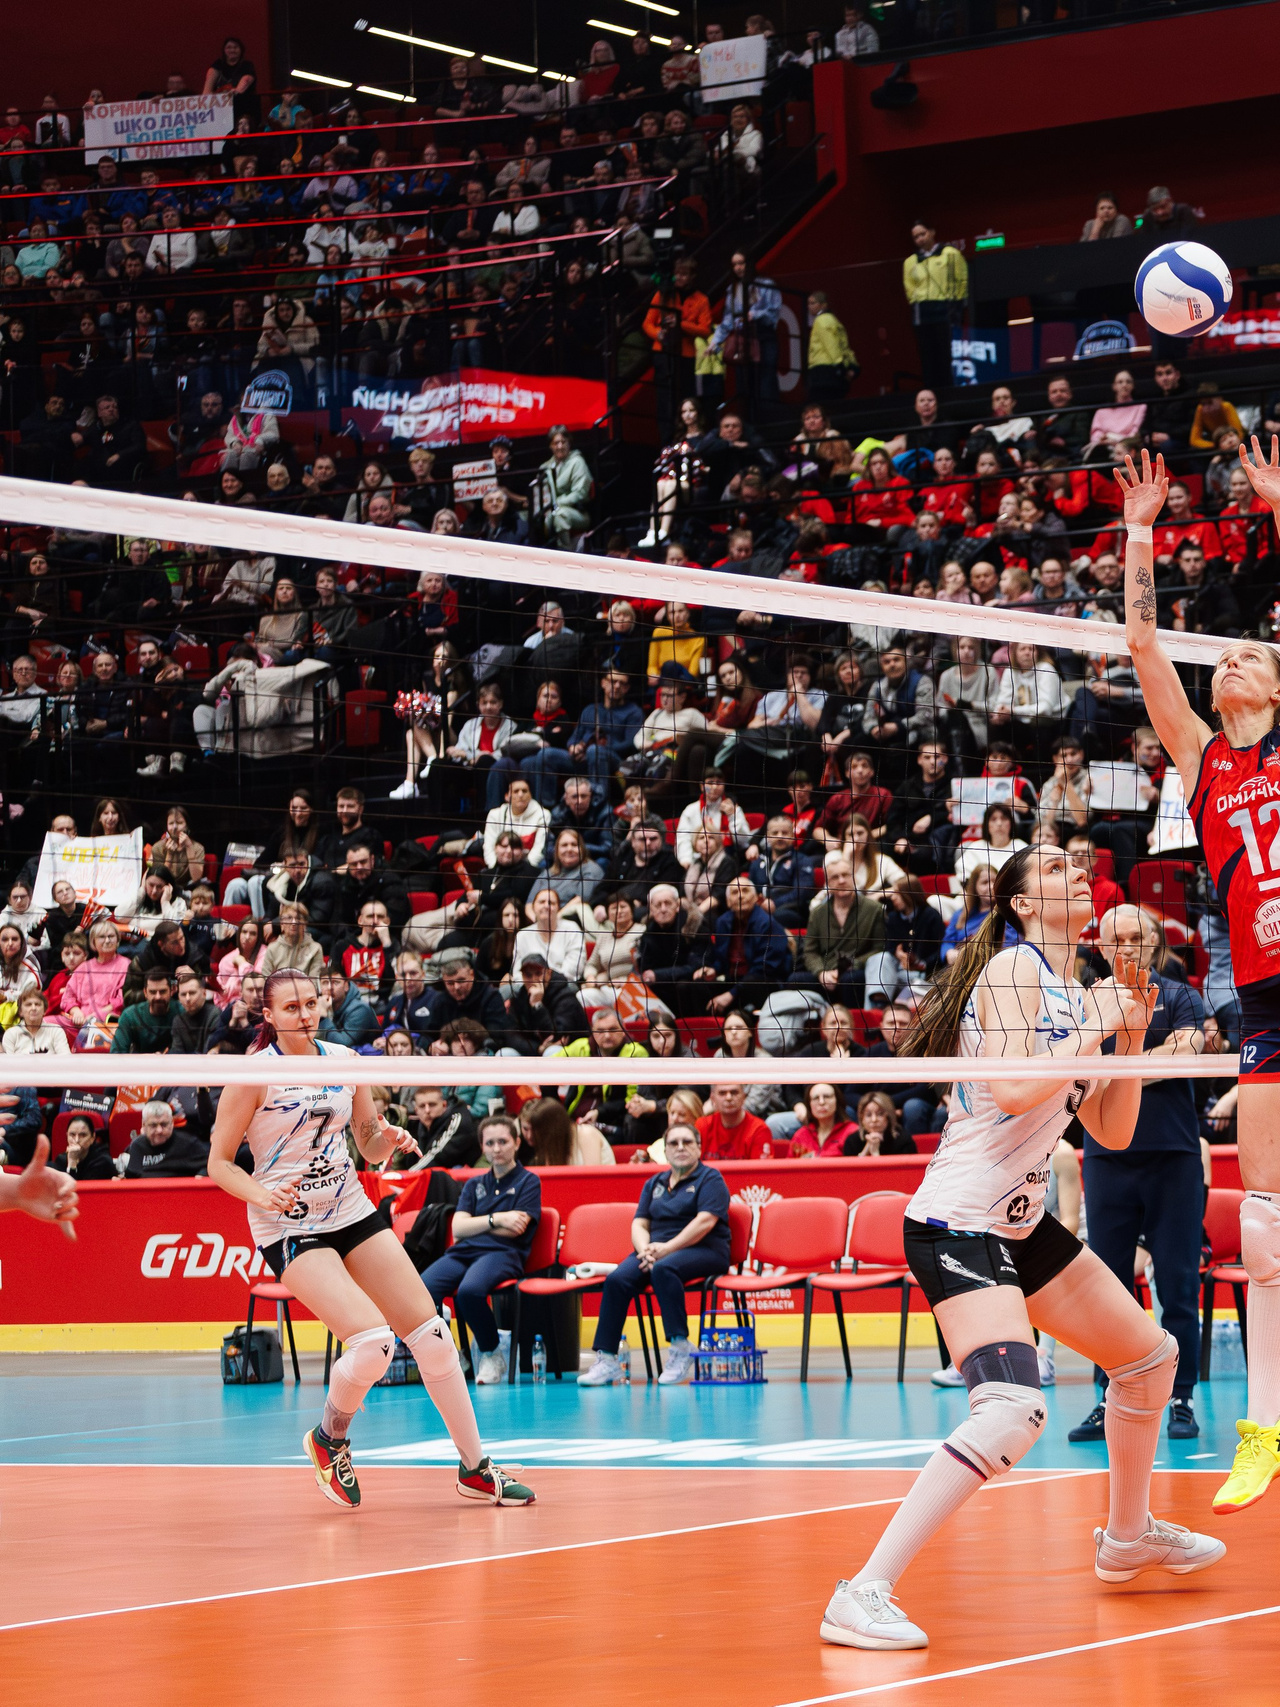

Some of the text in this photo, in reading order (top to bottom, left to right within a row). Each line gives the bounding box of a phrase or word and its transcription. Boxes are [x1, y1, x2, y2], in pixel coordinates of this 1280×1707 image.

[84, 94, 232, 121] КОРМИЛОВСКАЯ
[1242, 1045, 1257, 1064] 12
[312, 1093, 328, 1101] ВФВ
[308, 1106, 336, 1152] 7
